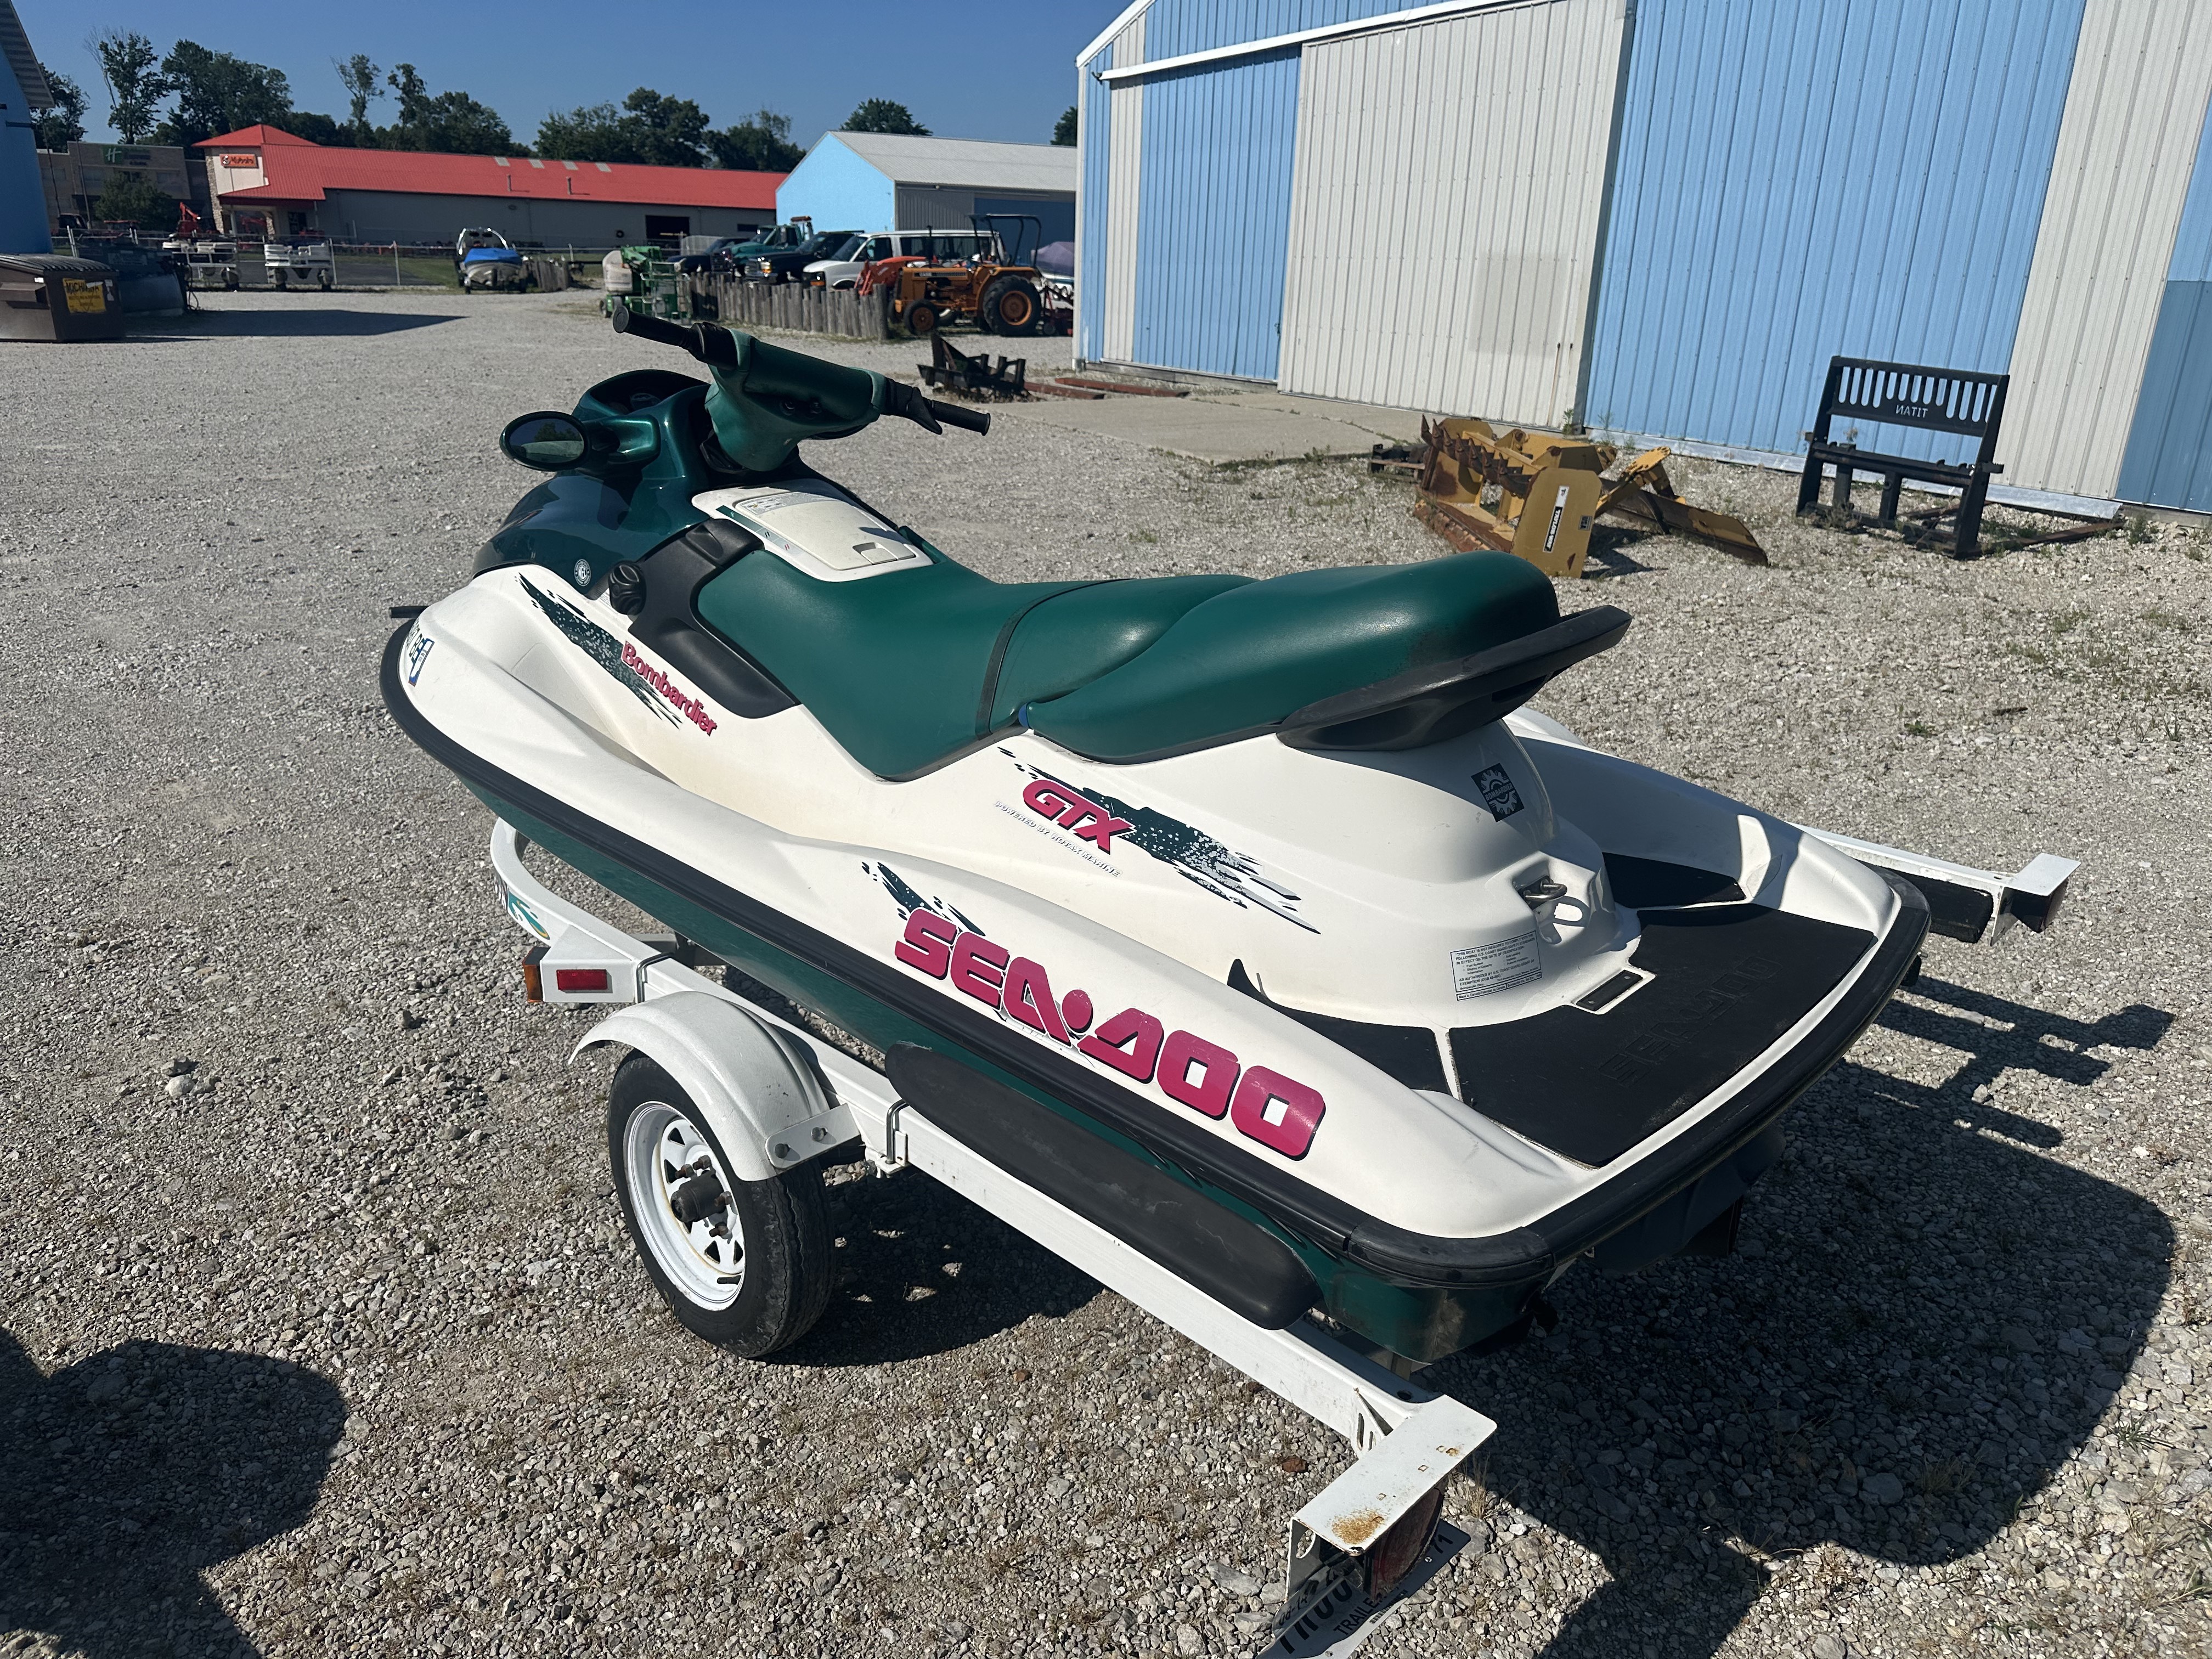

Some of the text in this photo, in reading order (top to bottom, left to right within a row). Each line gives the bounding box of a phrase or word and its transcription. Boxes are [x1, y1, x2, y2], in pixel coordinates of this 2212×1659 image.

[621, 641, 718, 736] Bombardier
[1023, 780, 1135, 855] GTX
[1485, 783, 1514, 802] BOMBARDIER
[995, 801, 1121, 877] POWERED BY ROTAX MARINE
[1333, 1592, 1383, 1635] TRAILE
